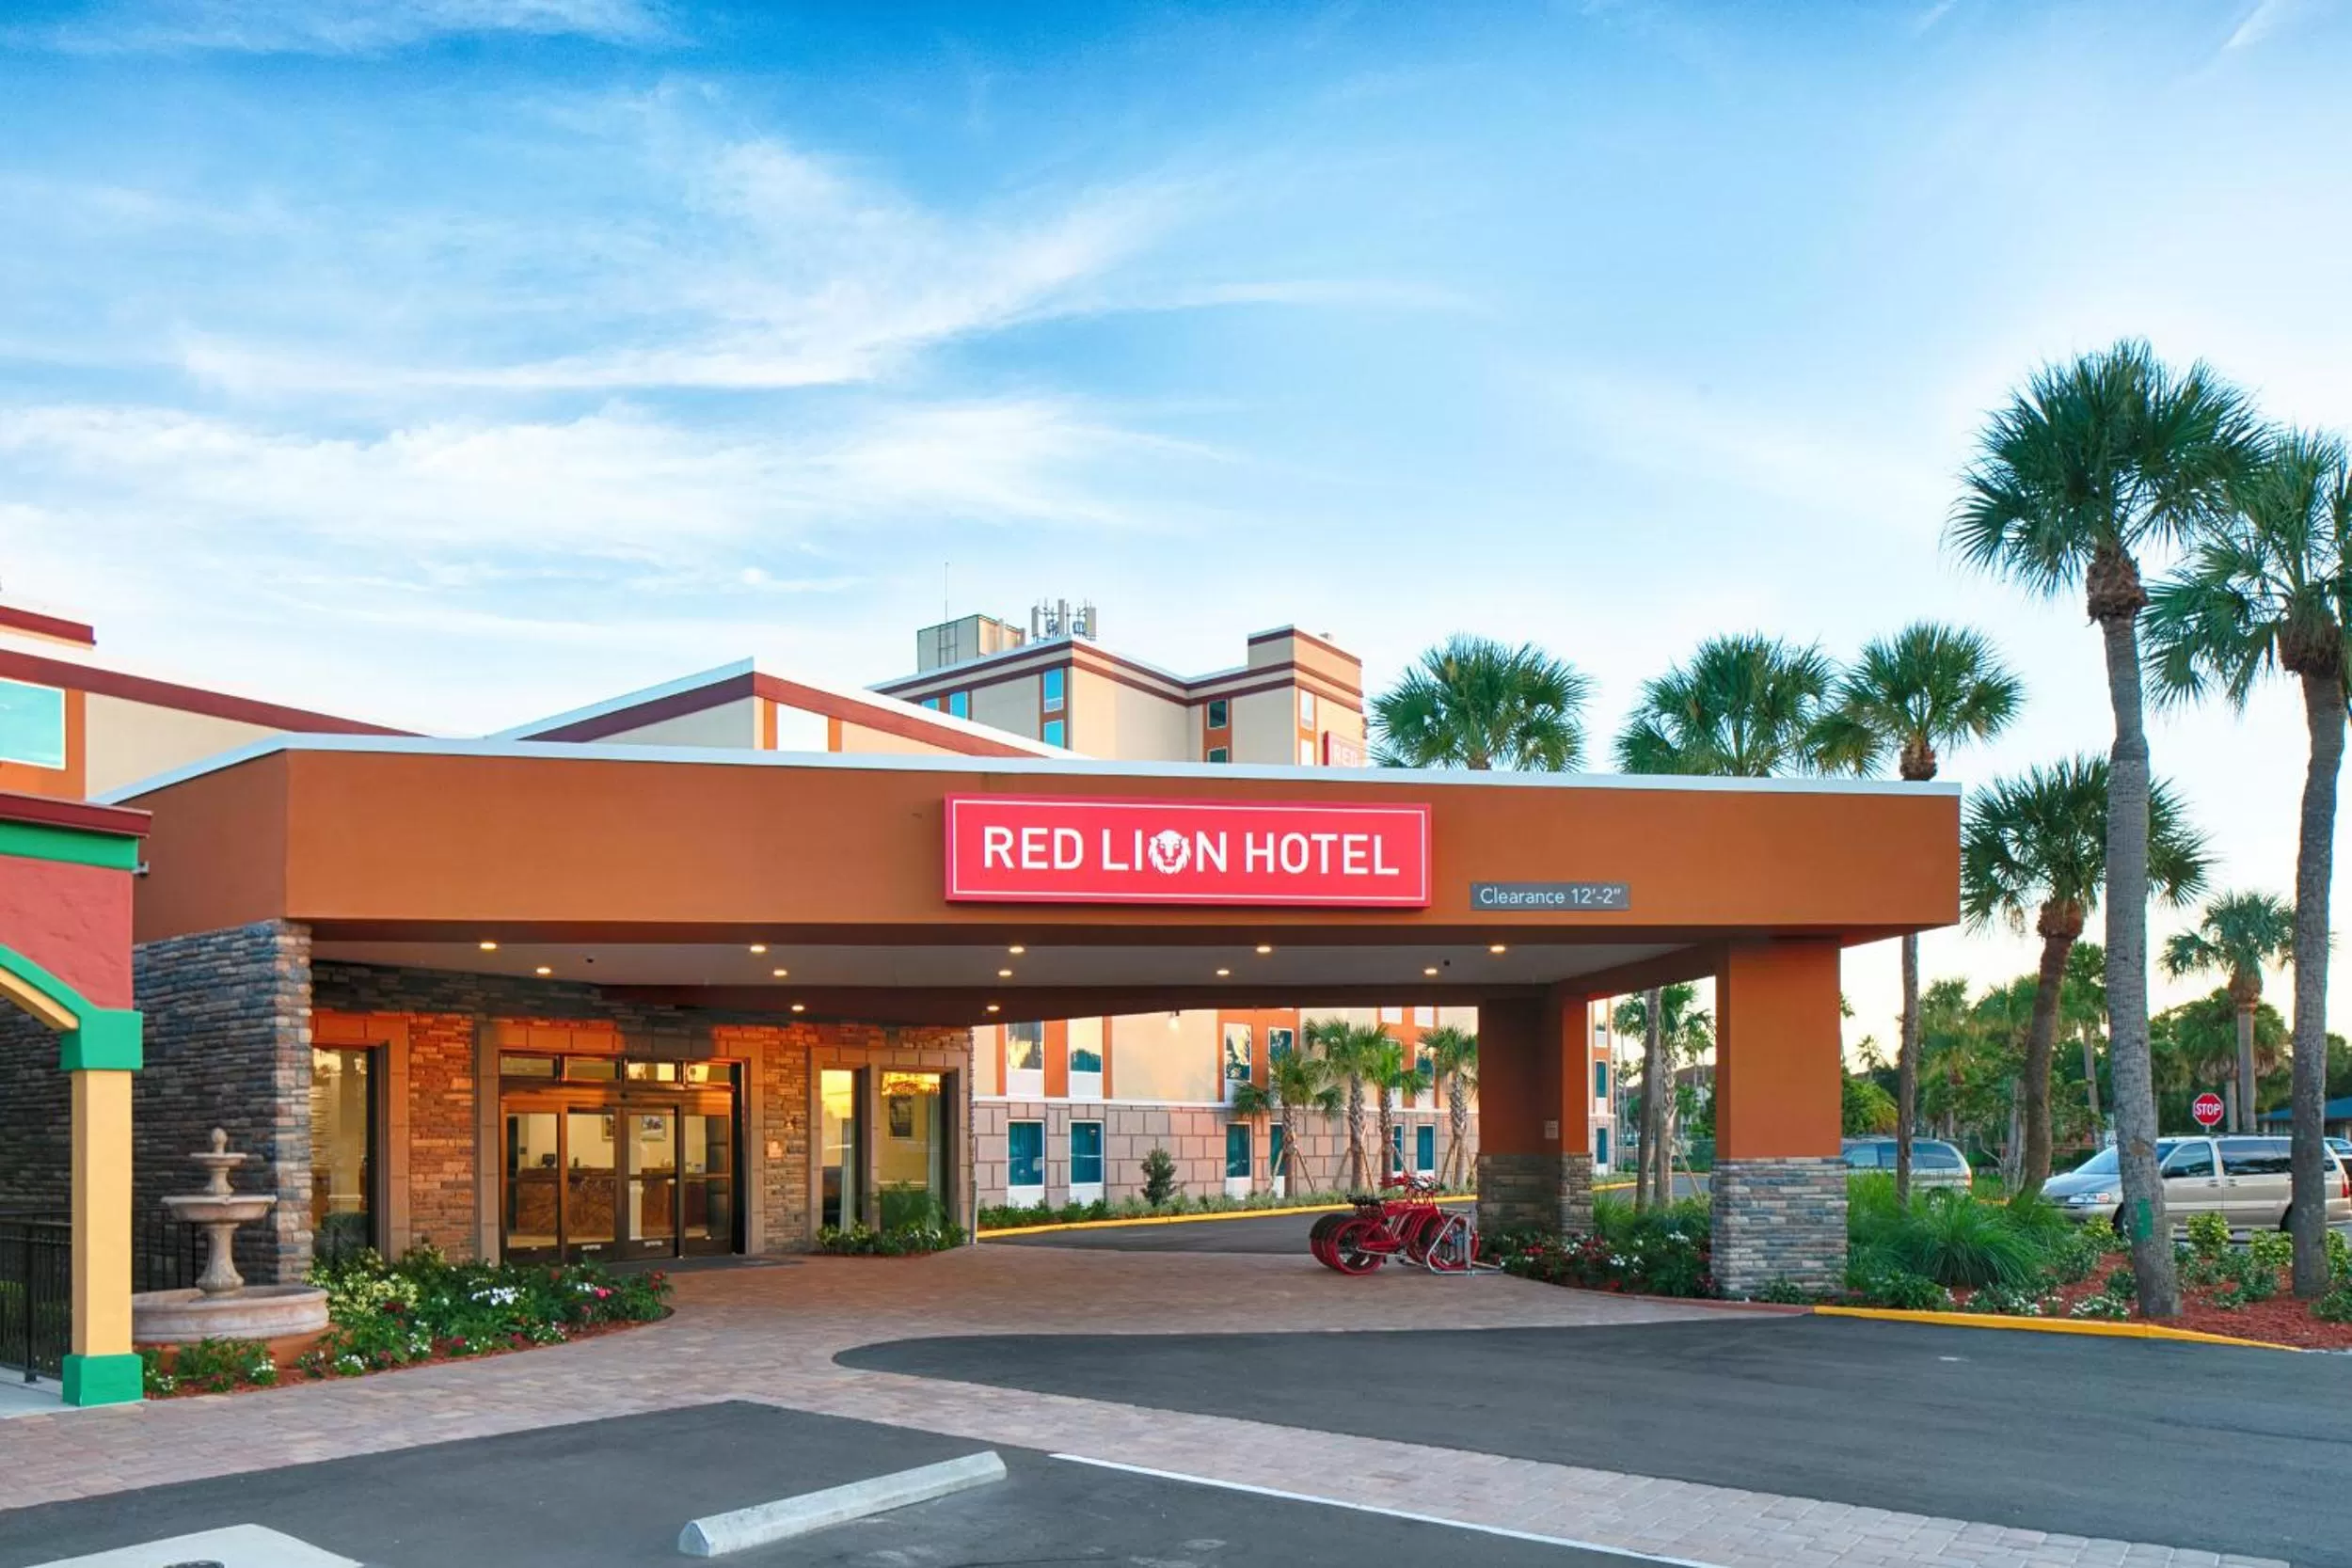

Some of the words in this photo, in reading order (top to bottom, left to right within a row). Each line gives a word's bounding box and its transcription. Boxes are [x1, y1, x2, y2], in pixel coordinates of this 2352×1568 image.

[984, 826, 1084, 869] RED
[1102, 828, 1227, 875] LION
[1246, 832, 1400, 875] HOTEL
[1480, 888, 1565, 904] Clearance
[1571, 888, 1621, 904] 12'-2"
[2196, 1103, 2221, 1116] STOP
